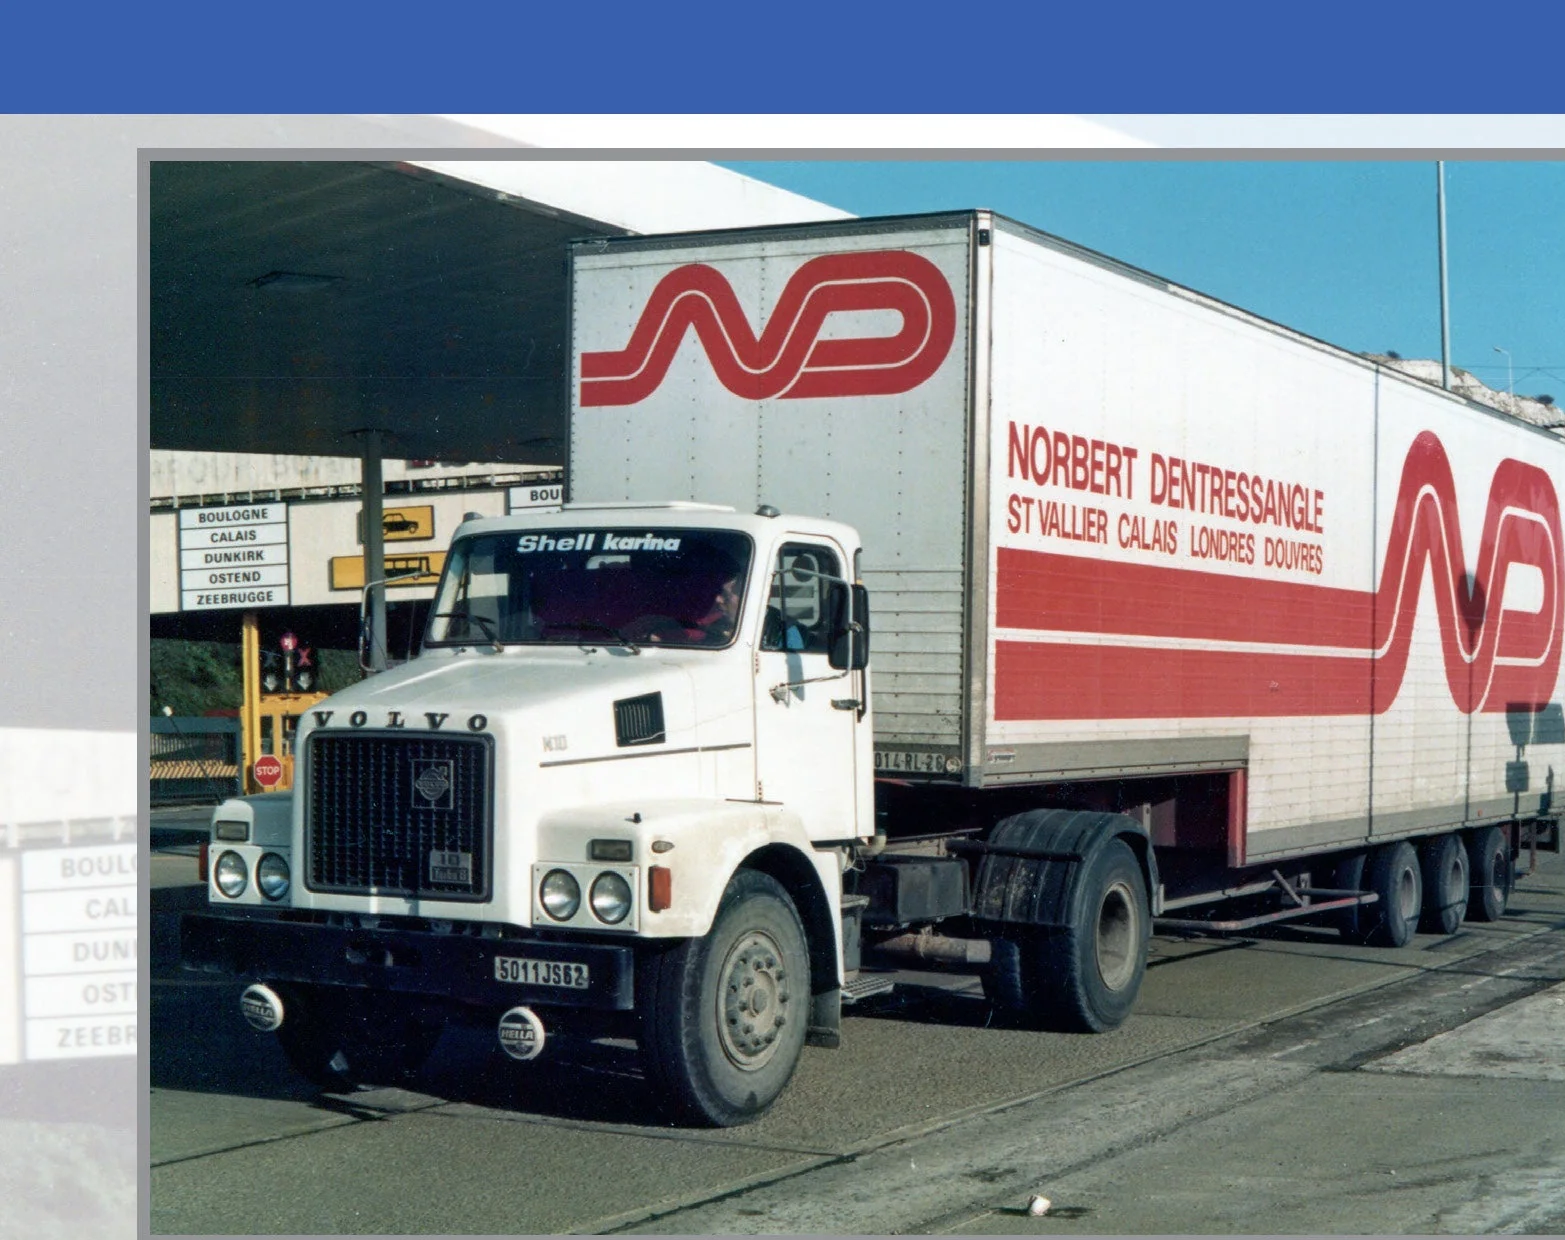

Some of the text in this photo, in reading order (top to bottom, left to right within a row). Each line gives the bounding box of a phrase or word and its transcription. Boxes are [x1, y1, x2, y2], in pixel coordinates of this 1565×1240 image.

[1008, 421, 1324, 534] NORBERT DENTRESSANGLE
[198, 508, 268, 523] BOULOGNE
[210, 530, 257, 543] CALAIS
[1007, 493, 1323, 575] ST VALLIER CALAIS LONDRES DOUVRES
[517, 533, 681, 553] Shell karina
[204, 550, 264, 564] DUNKIRK
[209, 571, 261, 584] OSTEND
[196, 591, 274, 605] ZEEBRUGGE
[312, 710, 489, 732] VOLVO
[255, 765, 280, 777] STOP
[73, 939, 137, 962] DUN
[500, 959, 585, 987] 5011JS62
[82, 982, 137, 1005] OST
[244, 1002, 275, 1018] HELLA
[501, 1029, 536, 1041] HELLA
